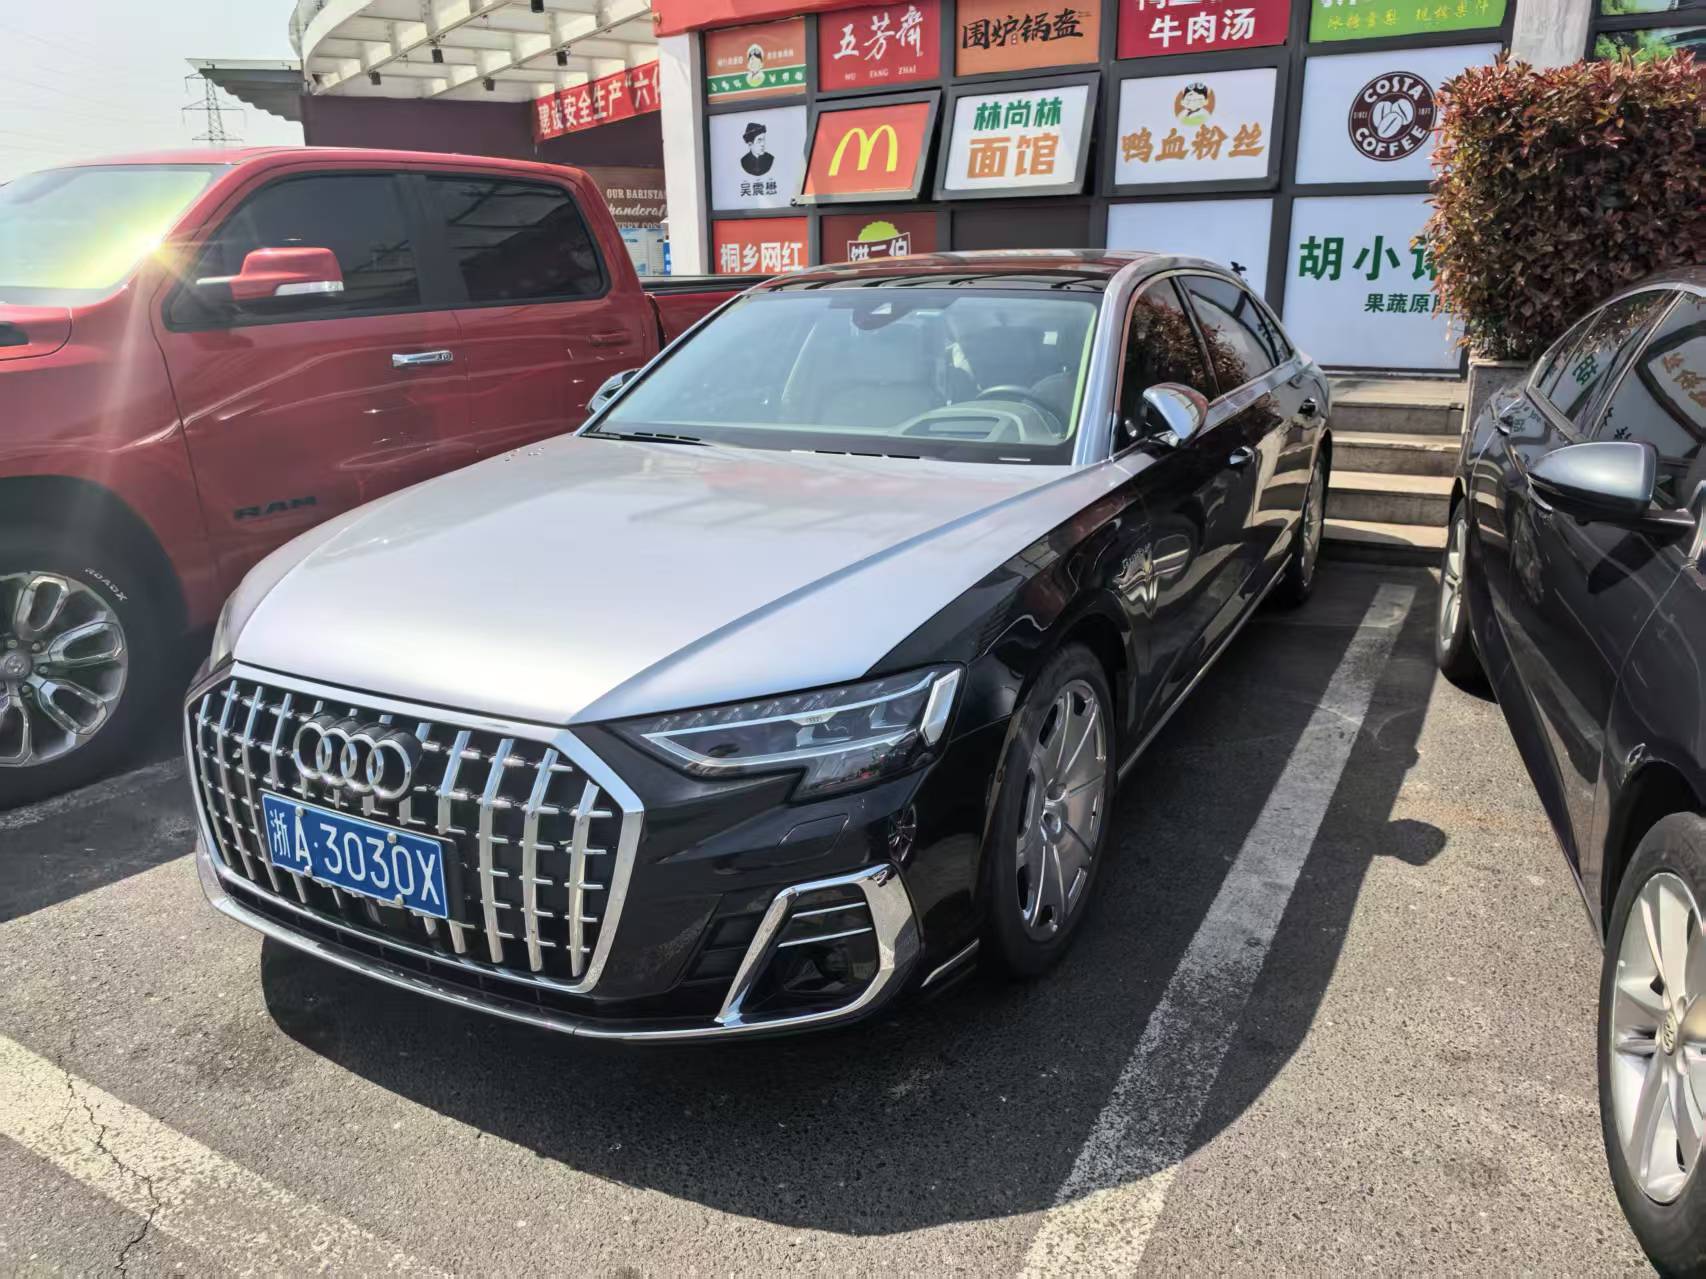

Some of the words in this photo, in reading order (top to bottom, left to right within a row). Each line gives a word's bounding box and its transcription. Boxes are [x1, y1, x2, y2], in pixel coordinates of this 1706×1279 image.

[1148, 8, 1255, 48] 牛肉汤
[1363, 76, 1424, 103] COSTA
[967, 132, 1059, 179] 面馆
[1121, 122, 1265, 163] 鸭血粉丝
[1355, 125, 1426, 156] COFFEE
[606, 188, 625, 199] OUR
[626, 189, 667, 200] BARISTA
[720, 242, 804, 273] 桐乡网红
[234, 496, 317, 521] RAM
